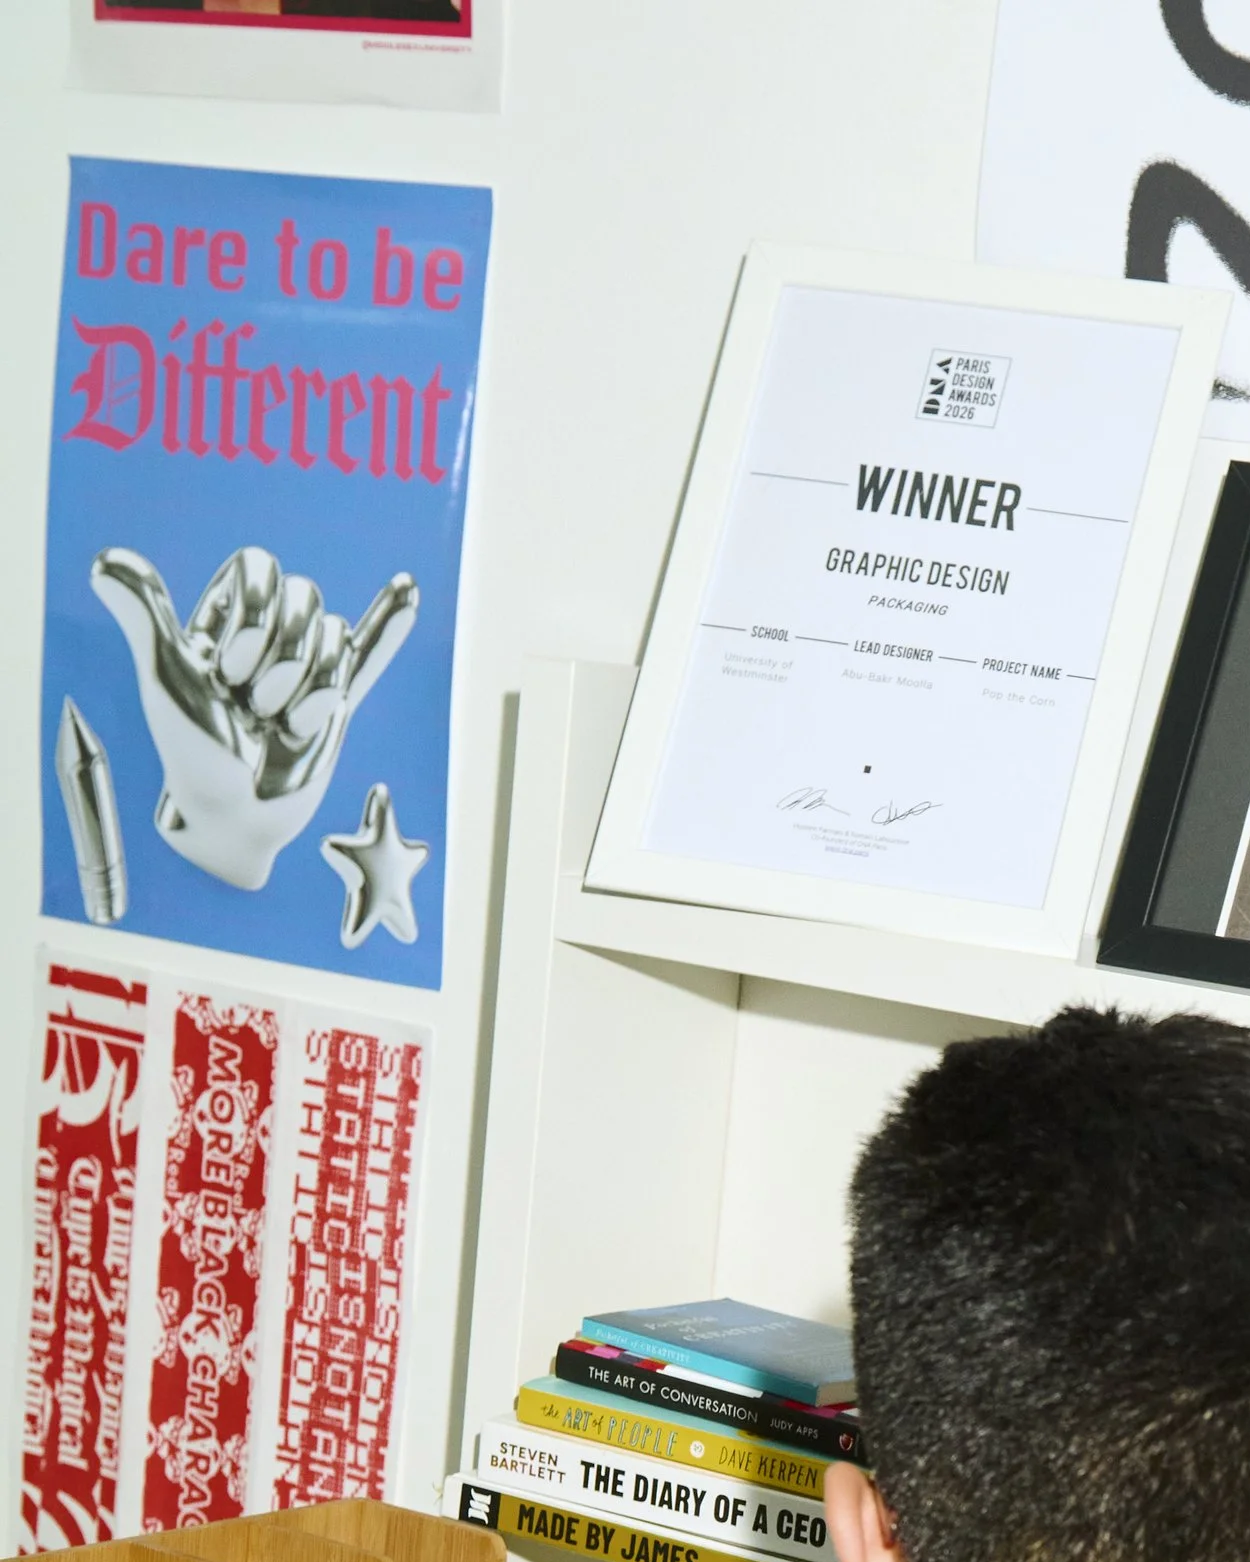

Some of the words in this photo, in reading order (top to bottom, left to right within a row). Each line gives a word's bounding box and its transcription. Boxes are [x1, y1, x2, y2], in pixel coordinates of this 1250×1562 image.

[78, 202, 247, 292] Dare
[275, 220, 348, 300] to
[373, 227, 464, 311] be
[951, 372, 994, 390] DESIGN
[955, 357, 990, 374] PARIS
[63, 314, 453, 486] Different
[943, 403, 975, 419] 2026
[947, 389, 996, 406] AWARDS
[856, 464, 1021, 531] WINNER
[825, 547, 923, 583] GRAPHIC
[926, 561, 1009, 595] DESIGN
[867, 595, 948, 615] PACKAGING
[750, 625, 788, 642] SCHOOL
[853, 640, 881, 654] LEAD
[882, 643, 933, 662] DESIGNER
[982, 657, 1027, 674] PROJECT
[1030, 664, 1062, 680] NAME
[202, 1037, 243, 1181] MORE
[193, 1188, 233, 1343] BLACK
[588, 1366, 609, 1383] THE
[614, 1374, 635, 1388] ART
[639, 1380, 656, 1394] OF
[660, 1386, 758, 1425] CONVERSATION
[562, 1407, 592, 1432] ART
[592, 1415, 603, 1435] of
[606, 1416, 678, 1456] PEOPLE
[769, 1418, 792, 1430] JUDY
[796, 1425, 818, 1439] APPS
[490, 1454, 566, 1483] BARTLETT
[500, 1441, 558, 1466] STEVEN
[718, 1445, 752, 1472] DAVE
[757, 1455, 817, 1488] KERPEN
[580, 1460, 625, 1497] THE
[633, 1473, 706, 1517] DIARY
[713, 1494, 746, 1526] OF
[752, 1504, 767, 1534] A
[776, 1509, 826, 1547] CEO
[517, 1503, 579, 1545] MADE
[585, 1522, 615, 1554] BY
